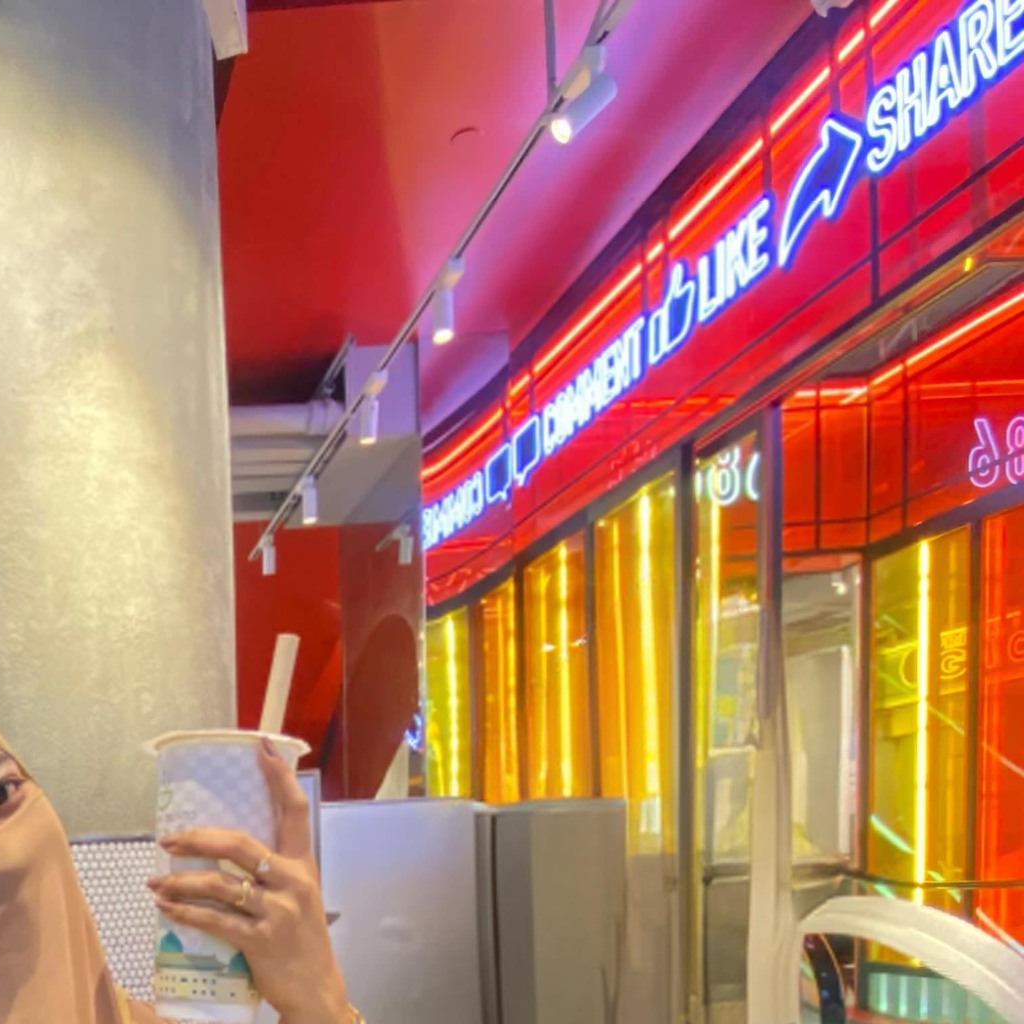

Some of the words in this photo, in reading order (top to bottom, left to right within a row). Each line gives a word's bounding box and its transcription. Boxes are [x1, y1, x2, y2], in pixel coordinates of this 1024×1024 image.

[542, 316, 645, 455] COMMENT
[697, 198, 770, 322] LIKE
[866, 0, 1024, 172] SHARE
